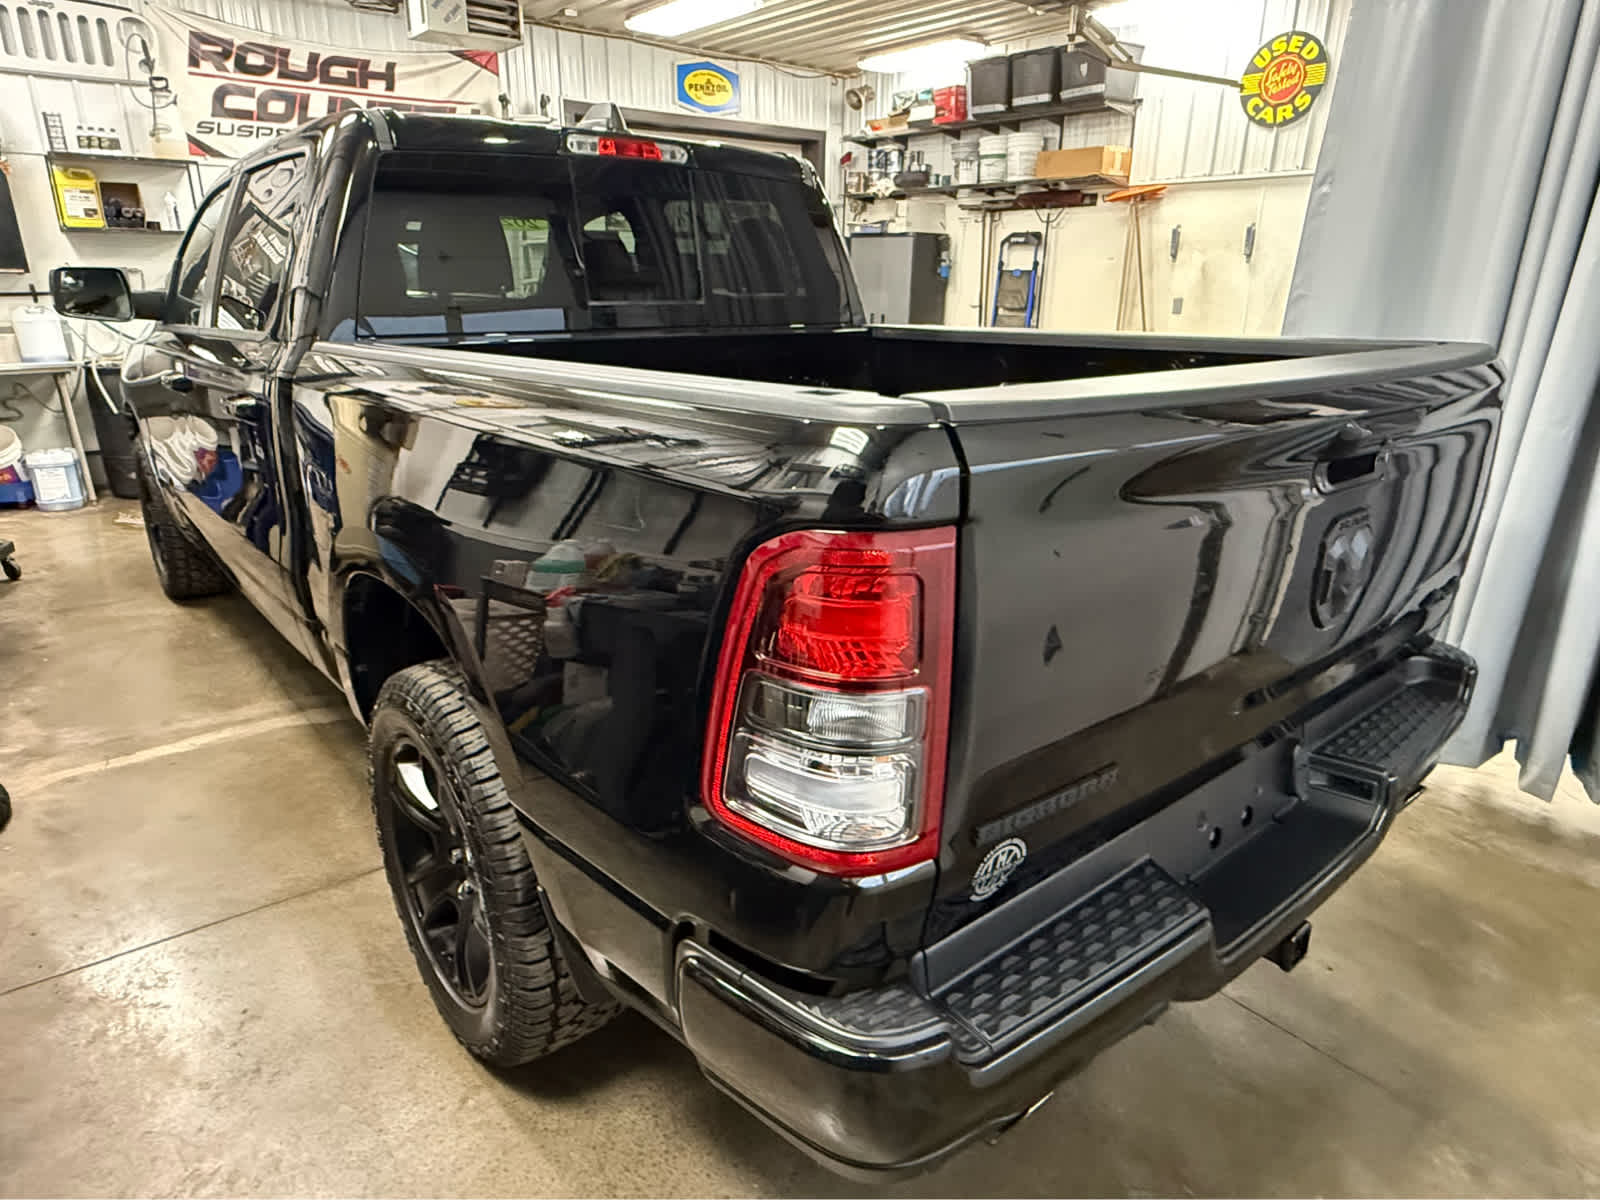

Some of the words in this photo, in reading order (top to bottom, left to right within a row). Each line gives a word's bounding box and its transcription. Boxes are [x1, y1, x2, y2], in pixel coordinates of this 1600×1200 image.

[188, 30, 397, 92] ROUGH
[1253, 35, 1319, 68] USED
[1246, 90, 1312, 124] CARS
